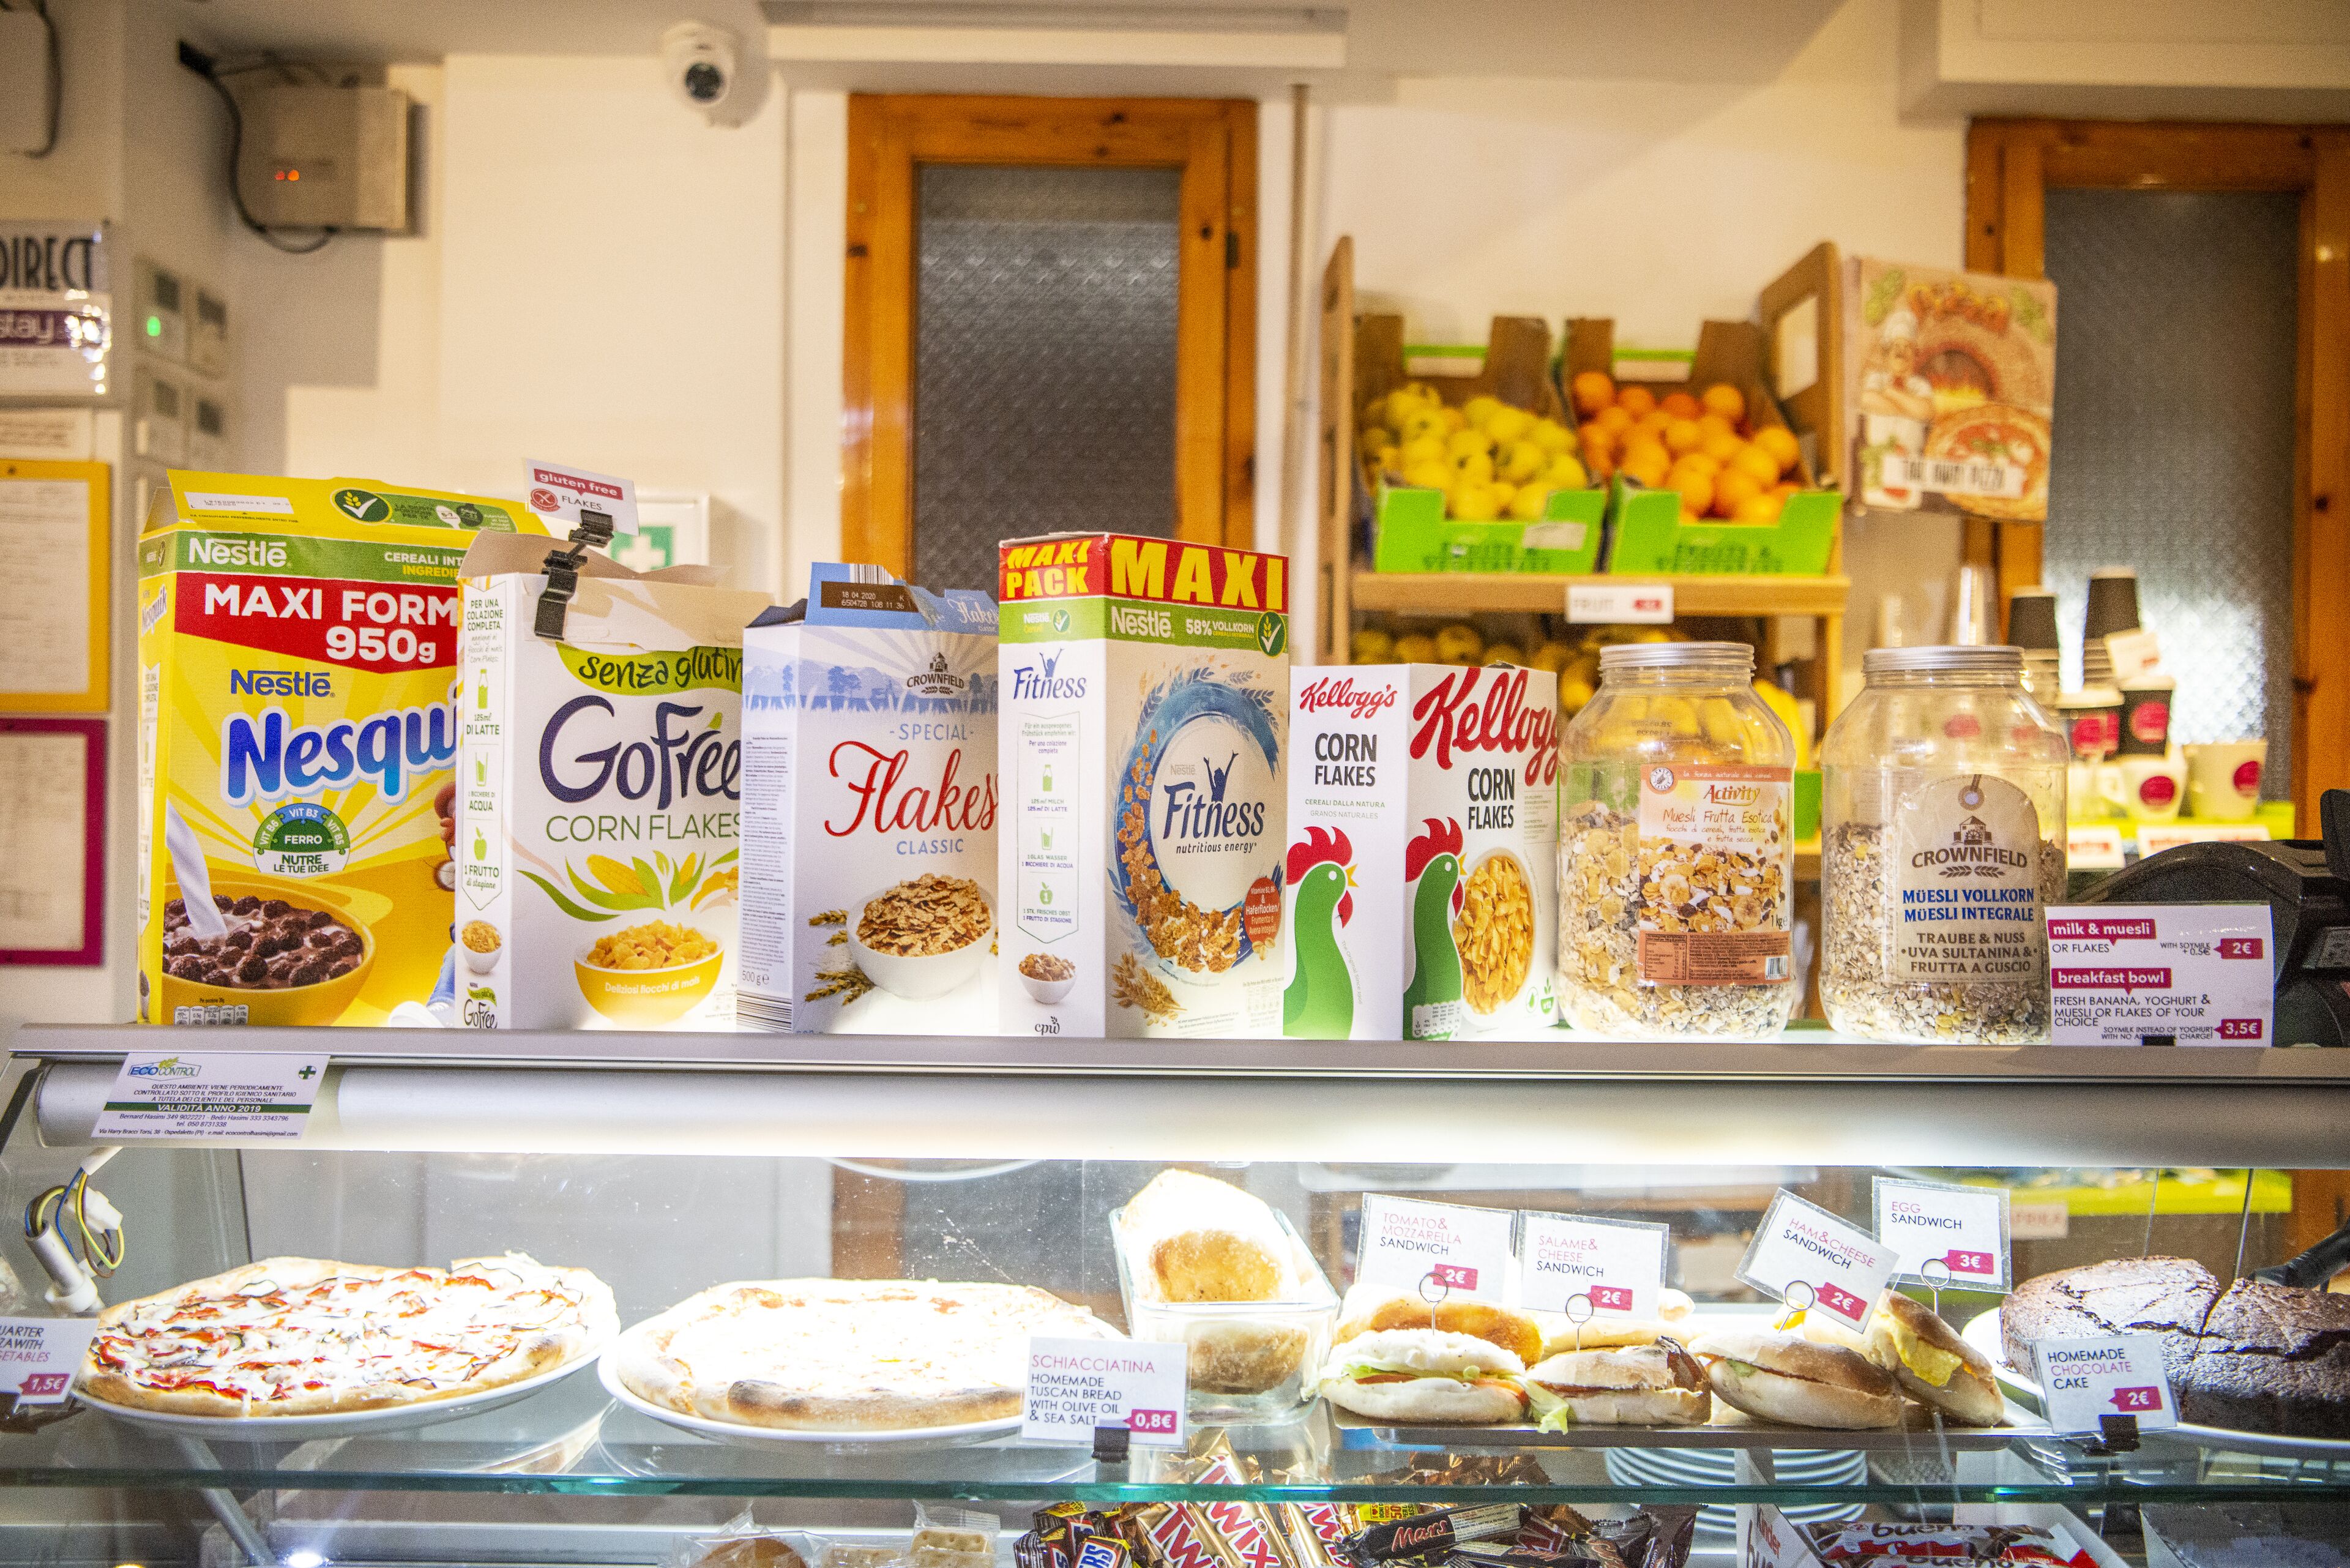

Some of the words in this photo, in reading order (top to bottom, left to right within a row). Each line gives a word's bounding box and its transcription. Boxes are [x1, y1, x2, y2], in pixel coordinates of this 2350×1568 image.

[539, 472, 586, 490] gluten
[589, 483, 617, 496] free
[562, 496, 602, 511] FLAKES
[1007, 540, 1092, 570] MAXI
[1005, 566, 1089, 599] PACK
[1111, 539, 1284, 611] MAXI
[205, 583, 323, 620] MAXI
[470, 599, 483, 609] PER
[484, 597, 499, 608] UNA
[466, 609, 504, 621] COLAZIONE
[1111, 606, 1172, 638] Nestlé
[1185, 618, 1212, 637] 58%
[1212, 620, 1255, 634] VOLLKORN
[325, 625, 436, 664] 950g
[578, 655, 669, 689] senza
[231, 669, 331, 698] Nestlé
[906, 673, 966, 690] CROWNFIELD
[1013, 666, 1087, 700] Fitness
[1299, 676, 1398, 720] Kellogg's
[474, 713, 493, 722] 125ml
[466, 724, 474, 736] DI
[474, 724, 500, 736] LATTE
[898, 723, 969, 742] SPECIAL
[224, 698, 457, 800] Nesqu
[1315, 732, 1378, 763] CORN
[1314, 764, 1376, 788] FLAKES
[1468, 767, 1516, 802] CORN
[824, 741, 999, 837] Flakes
[1703, 783, 1761, 807] Activity
[469, 799, 494, 813] ACQUA
[1162, 781, 1265, 840] Fitness
[1305, 798, 1332, 807] CEREALI
[1333, 799, 1354, 808] DALLA
[1355, 799, 1386, 808] NATURA
[1310, 810, 1337, 818] GRANOS
[1338, 810, 1379, 819] NATURALES
[1468, 805, 1515, 831] FLAKES
[1662, 805, 1696, 824] Muesli
[1703, 808, 1736, 824] Frutta
[1741, 808, 1774, 824] Esotica
[545, 815, 640, 843] CORN
[284, 835, 323, 845] FERRO
[896, 838, 964, 856] CLASSIC
[1176, 842, 1222, 854] nutritious
[282, 854, 323, 865] NUTRE
[1911, 847, 2028, 870] CROWNFIELD
[274, 864, 286, 873] LE
[287, 864, 306, 873] TUE
[308, 863, 330, 873] IDEE
[1902, 888, 1959, 905] MÜESLI
[1961, 887, 2035, 903] VOLLKORN
[1904, 906, 1958, 923] MÜESLI
[1961, 906, 2034, 922] INTEGRALE
[2053, 921, 2084, 936] milk
[2087, 922, 2100, 935] &
[2103, 922, 2150, 936] muesli
[1916, 932, 1976, 945] TRAUBE
[1979, 932, 1991, 944] &
[1993, 931, 2026, 944] NUSS
[2179, 942, 2211, 950] SOYMILK
[1908, 947, 1939, 959] UVA
[1942, 947, 2020, 959] SULTANINA
[2021, 947, 2032, 958] &
[2052, 943, 2068, 954] OR
[2072, 943, 2110, 954] FLAKES
[2232, 942, 2252, 955] 2€
[1910, 961, 1968, 974] FRUTTA
[1971, 961, 1982, 973] A
[1984, 960, 2031, 973] GUSCIO
[605, 980, 639, 995] Deliziosi
[640, 980, 670, 994] fiocchi
[671, 979, 679, 990] di
[681, 975, 700, 989] mais
[2057, 971, 2125, 984] breakfast
[2128, 971, 2165, 984] bowl
[2054, 996, 2086, 1006] FRESH
[2089, 996, 2141, 1007] BANANA,
[2144, 996, 2197, 1006] YOGHURT
[2201, 994, 2211, 1006] &
[2054, 1007, 2092, 1018] MUESLI
[2095, 1007, 2112, 1018] OR
[2115, 1007, 2152, 1018] FLAKES
[2156, 1007, 2171, 1018] OF
[2174, 1007, 2205, 1017] YOUR
[2054, 1017, 2099, 1028] CHOICE
[2225, 1021, 2258, 1036] 3,5€
[157, 1102, 204, 1113] VALIDITÀ
[205, 1104, 237, 1113] ANNO
[238, 1105, 262, 1113] 2019
[1891, 1201, 1921, 1214] EGG
[1891, 1213, 1963, 1230] SANDWICH
[1381, 1225, 1462, 1246] MOZZARELLA
[1379, 1236, 1449, 1256] SANDWICH
[1783, 1229, 1852, 1270] SANDWICH
[1537, 1248, 1583, 1264] CHEESE
[1959, 1254, 1981, 1269] 3€
[1445, 1268, 1466, 1285] 2€
[1536, 1260, 1605, 1278] SANDWICH
[1600, 1289, 1621, 1305] 2€
[1833, 1291, 1854, 1311] 2€
[1031, 1354, 1155, 1374] SCHIACCIATINA
[2048, 1348, 2126, 1363] HOMEMADE
[2051, 1361, 2133, 1376] CHOCOLATE
[31, 1378, 65, 1392] 1,5€
[1031, 1373, 1105, 1387] HOMEMADE
[2053, 1377, 2089, 1390] CAKE
[1031, 1386, 1078, 1399] TUSCAN
[1082, 1389, 1122, 1401] BREAD
[2127, 1392, 2150, 1406] 2€
[1030, 1399, 1058, 1411] WITH
[1062, 1400, 1097, 1414] OLIVE
[1101, 1403, 1121, 1414] OIL
[1029, 1409, 1039, 1421] &
[1043, 1412, 1066, 1424] SEA
[1070, 1414, 1097, 1426] SALT
[1135, 1413, 1172, 1430] 0,8€
[1391, 1520, 1448, 1553] Mars
